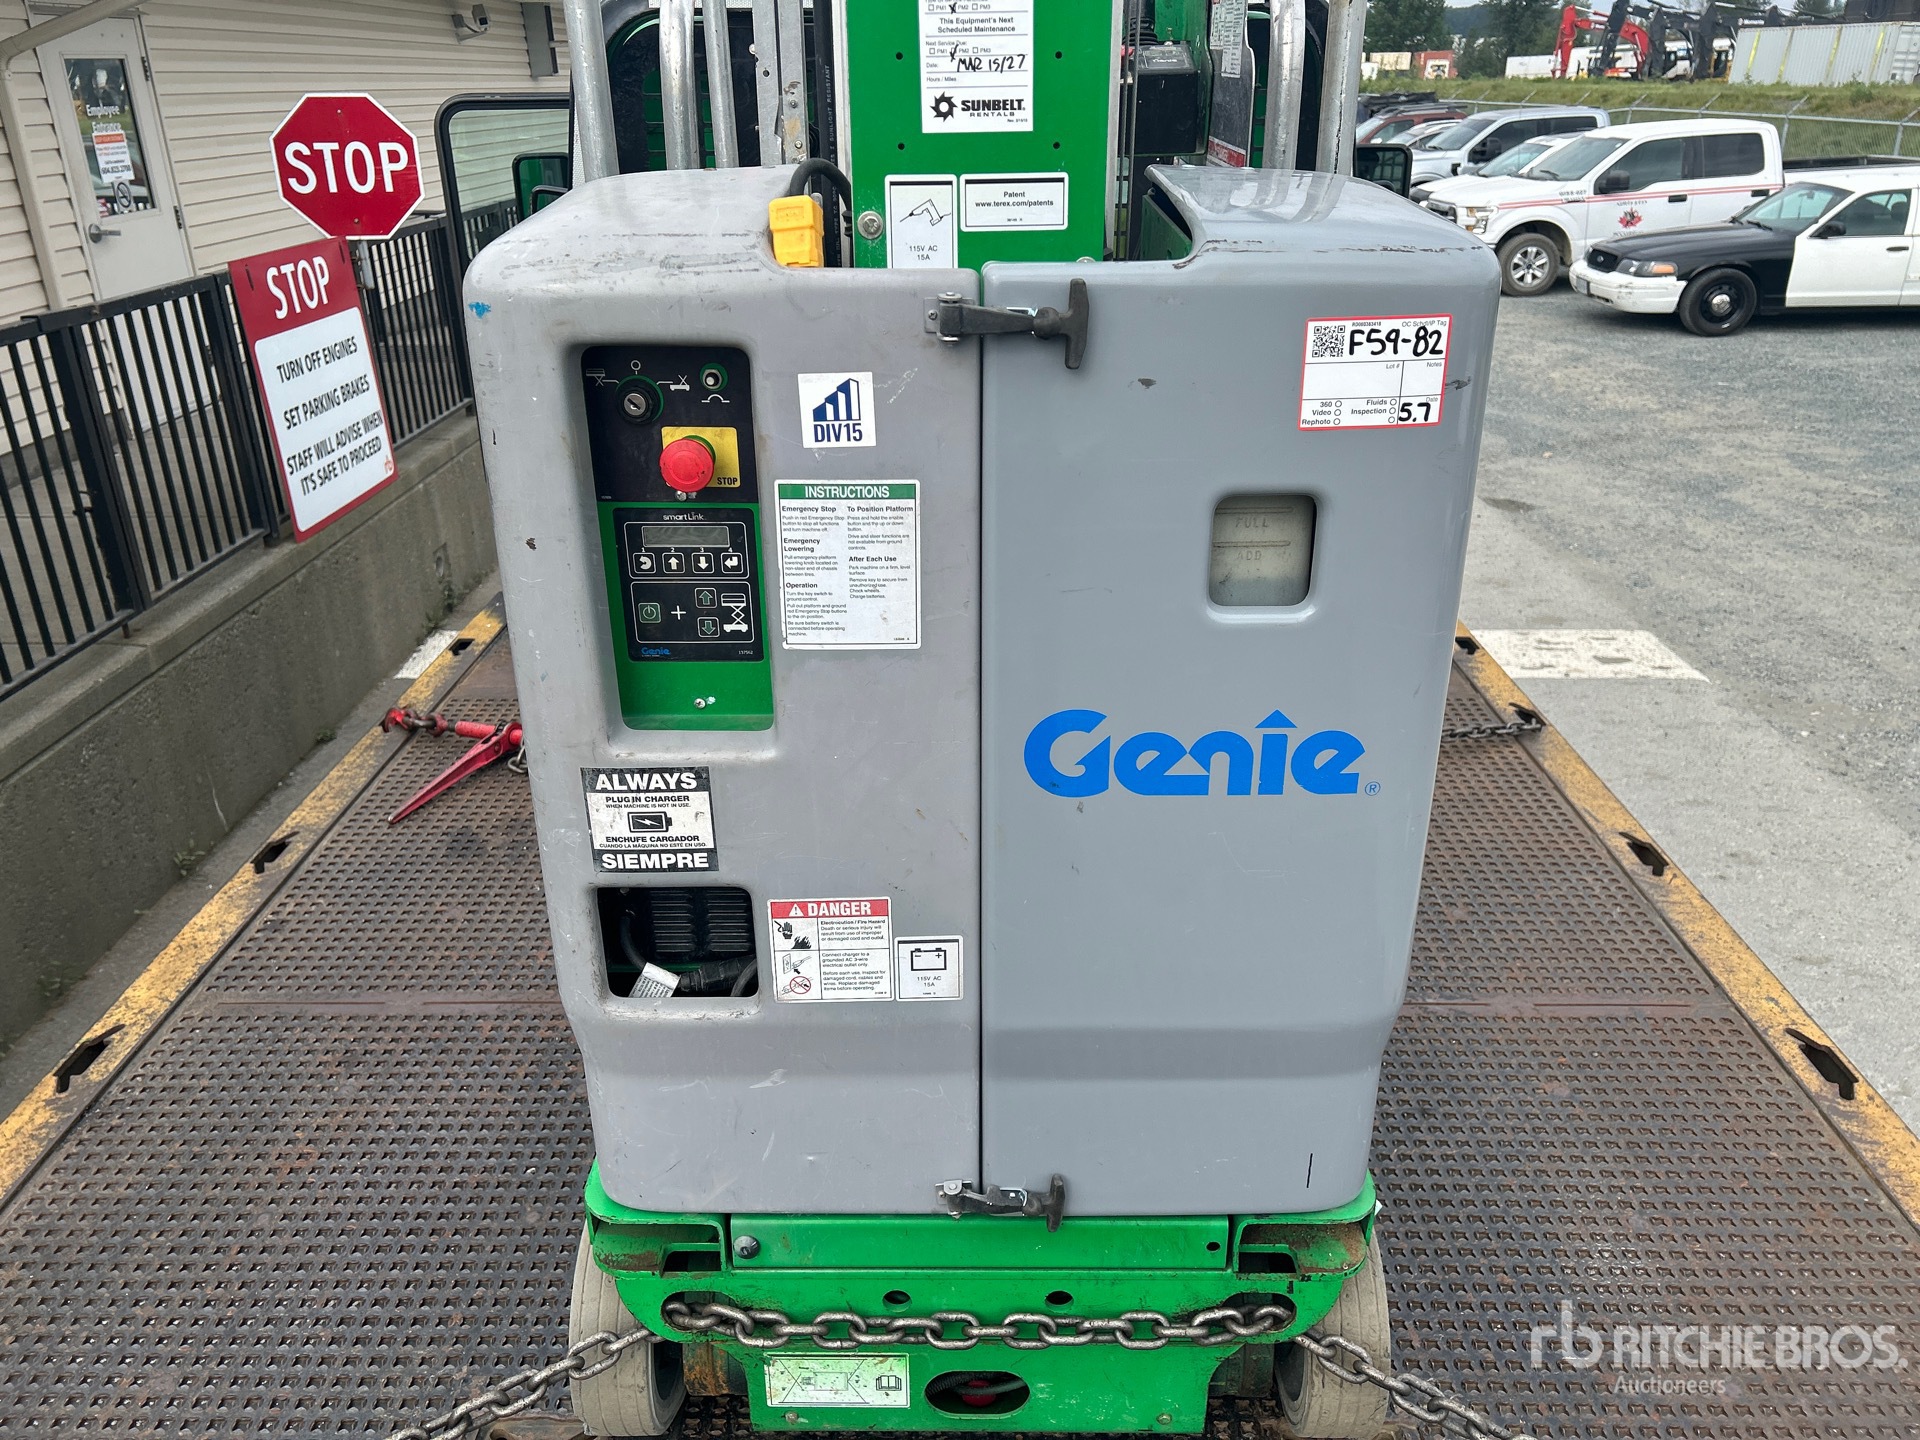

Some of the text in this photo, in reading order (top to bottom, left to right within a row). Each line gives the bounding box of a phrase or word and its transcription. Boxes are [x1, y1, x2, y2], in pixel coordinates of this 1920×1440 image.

[957, 57, 983, 72] MAR
[86, 103, 120, 118] Employee
[285, 141, 408, 194] STOP
[266, 256, 330, 320] STOP
[1349, 326, 1443, 357] F59-82
[276, 336, 358, 384] TURN OFF ENGINES
[283, 374, 371, 431] SET PARKING BRAKES
[1398, 402, 1431, 422] 5.7
[814, 423, 863, 442] DIV15
[286, 410, 384, 476] STAFF WILL ADVISE WHEN
[300, 435, 382, 497] IT'S SAFE TO PROCEED
[717, 477, 738, 485] STOP
[805, 486, 889, 498] INSTRUCTIONS
[663, 512, 704, 520] smartLink
[1023, 708, 1366, 798] Genie
[596, 772, 697, 790] ALWAYS
[602, 853, 709, 869] SIEMPRE
[808, 902, 871, 916] DANGER
